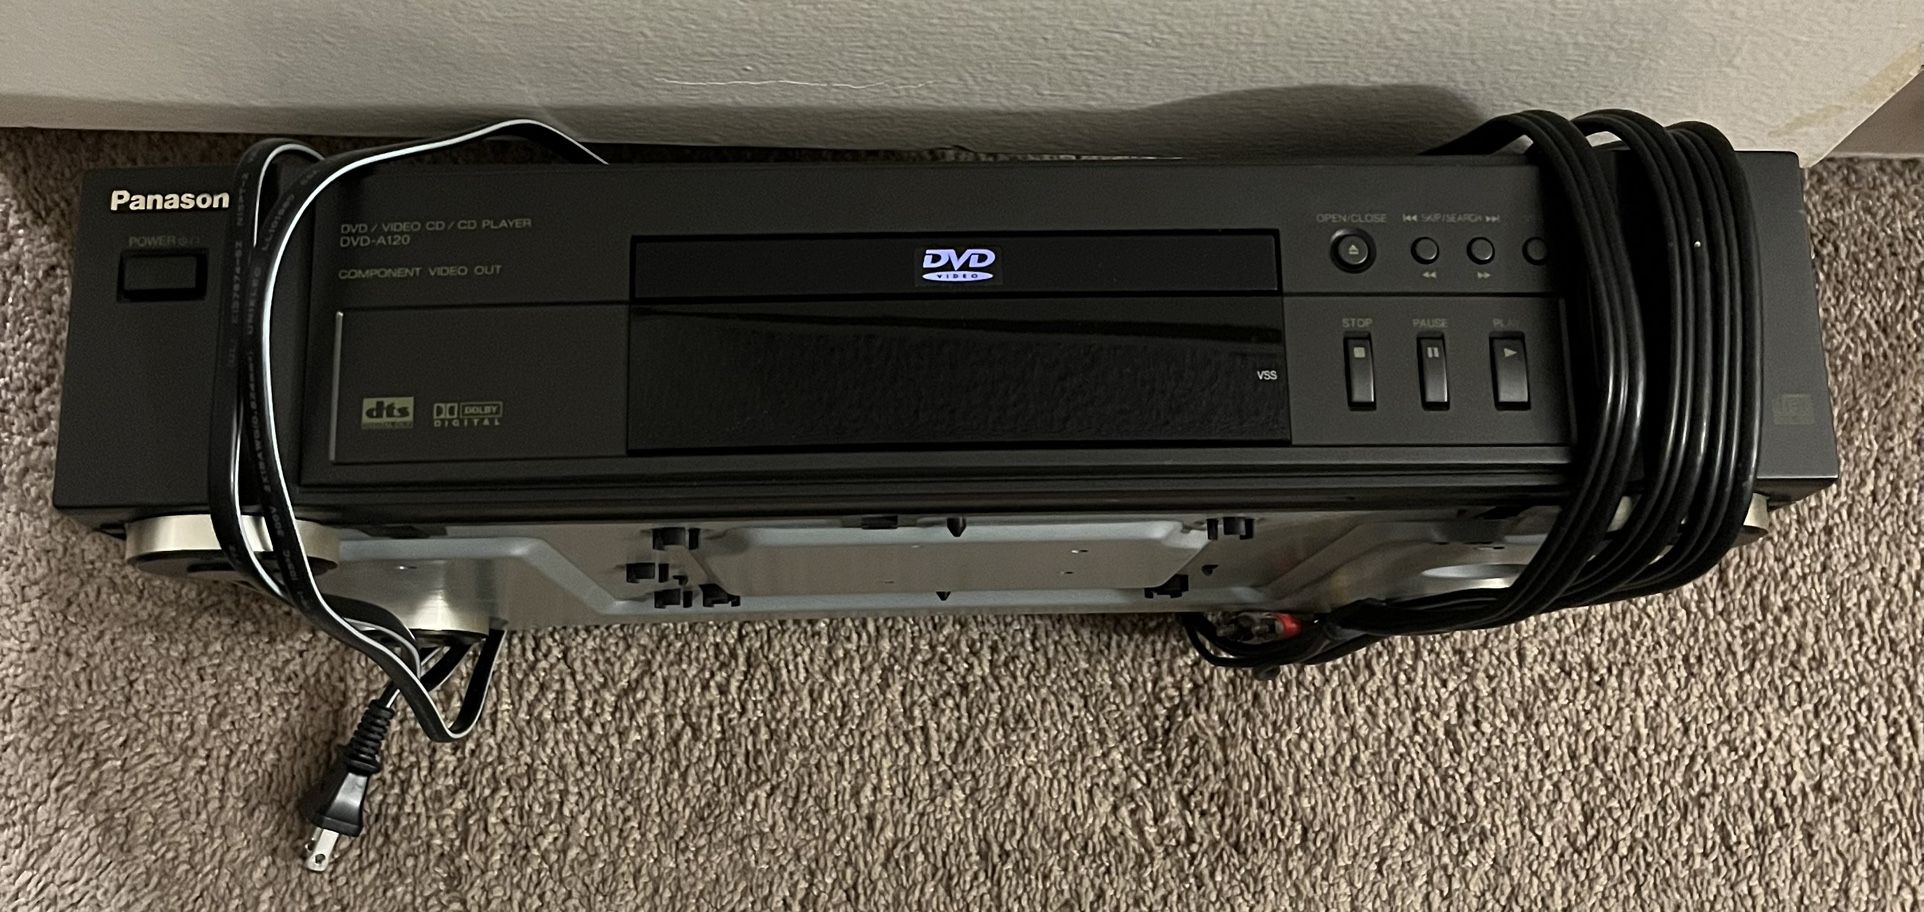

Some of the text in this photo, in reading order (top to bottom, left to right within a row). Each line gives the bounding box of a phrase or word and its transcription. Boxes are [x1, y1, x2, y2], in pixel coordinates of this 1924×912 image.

[110, 189, 230, 211] Panason
[1316, 213, 1387, 223] OPEN/CLOSE
[340, 223, 368, 234] DVD
[382, 221, 421, 233] VIDEO
[425, 220, 445, 231] CD
[457, 219, 477, 230] CD
[481, 218, 532, 230] PLAYER
[128, 235, 176, 248] POWER
[340, 234, 411, 247] DVD-A120
[922, 248, 996, 271] DVD
[338, 264, 503, 280] COMPONENT VIDEO OUT
[1341, 318, 1373, 328] STOP
[1412, 318, 1448, 328] PAUSE
[1256, 370, 1278, 381] VSS
[365, 400, 410, 419] dts
[464, 406, 498, 415] DOLBY
[433, 418, 501, 427] DIGITAL
